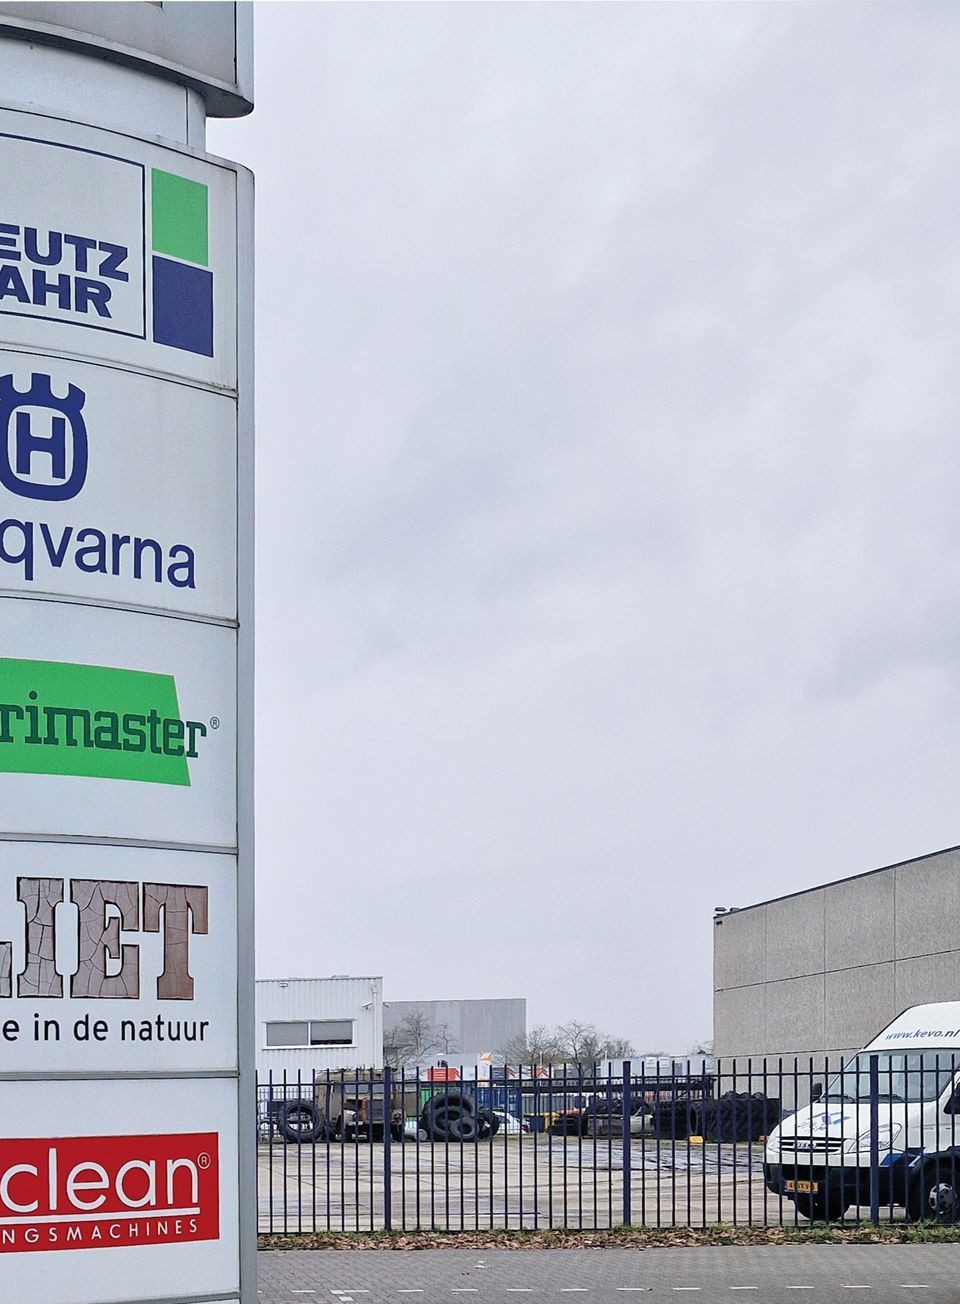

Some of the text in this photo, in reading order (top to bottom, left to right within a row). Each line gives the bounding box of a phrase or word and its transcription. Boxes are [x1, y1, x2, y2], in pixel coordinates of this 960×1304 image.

[33, 1012, 60, 1042] in
[73, 1013, 109, 1042] de
[121, 1014, 210, 1042] natuur
